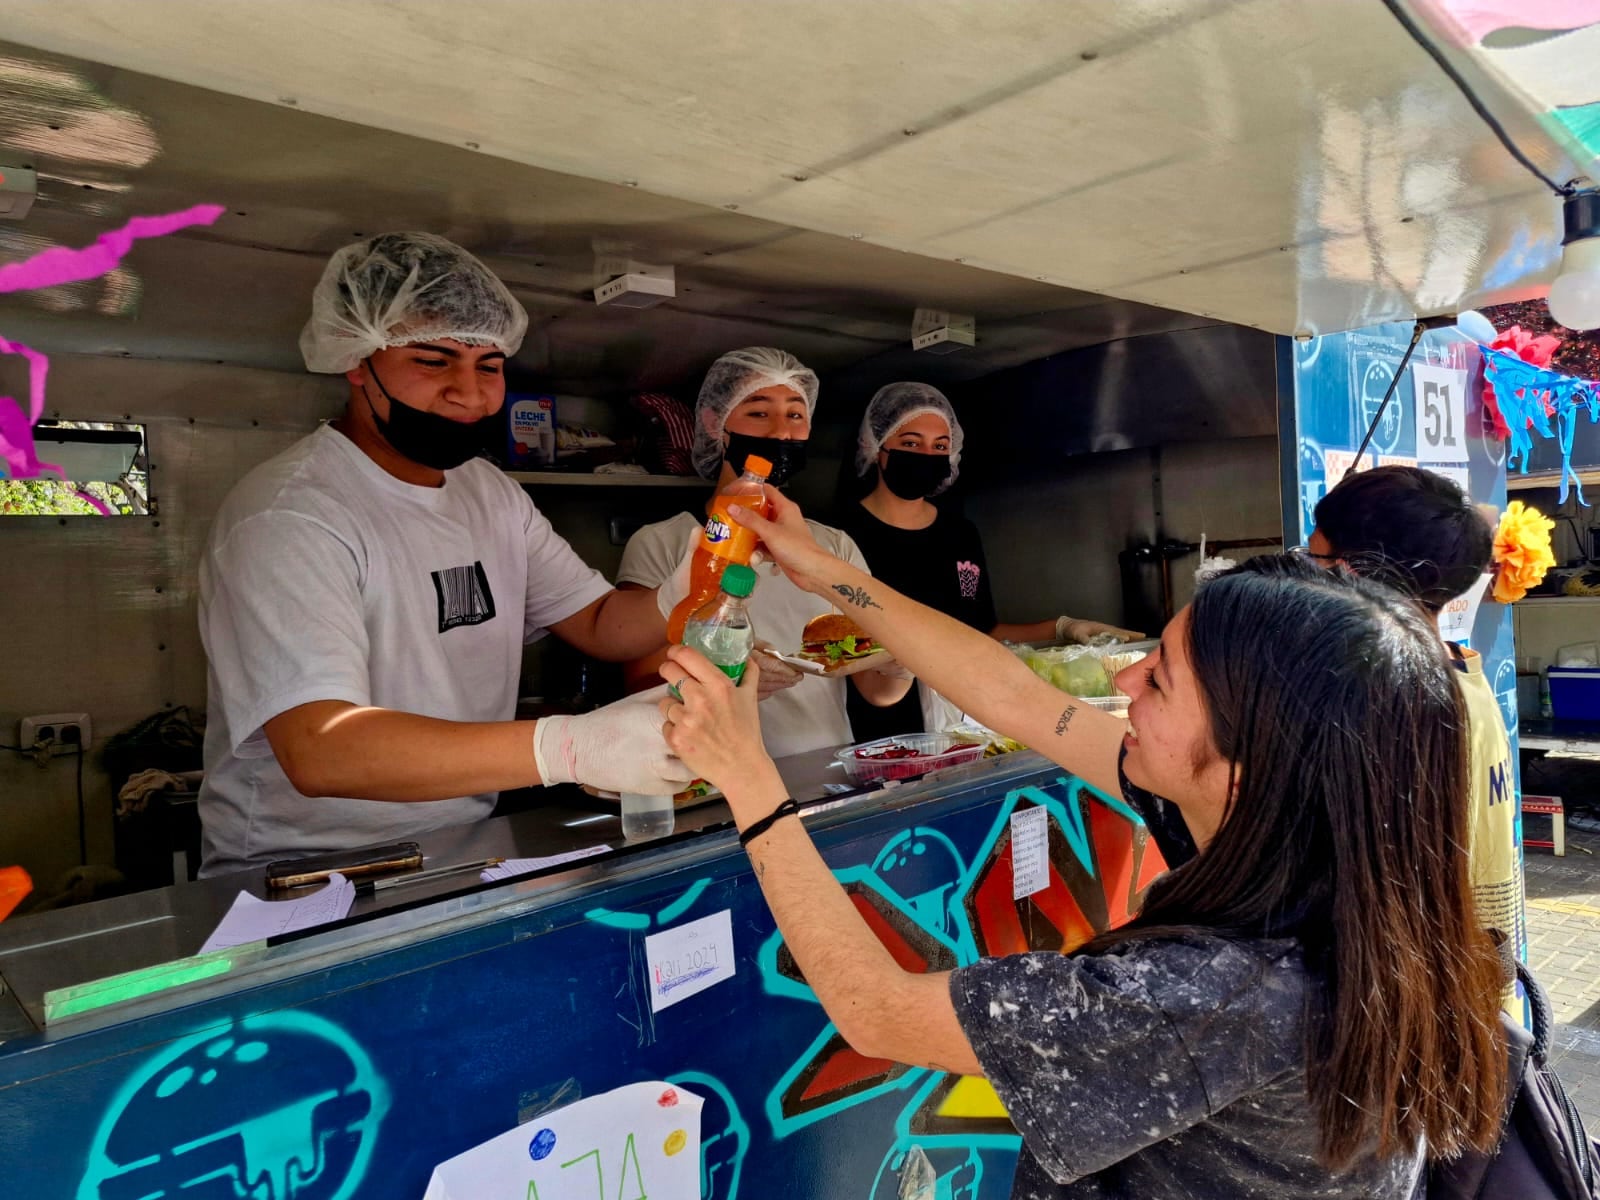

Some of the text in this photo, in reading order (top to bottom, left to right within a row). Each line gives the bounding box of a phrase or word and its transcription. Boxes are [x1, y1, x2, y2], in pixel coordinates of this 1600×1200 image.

[515, 411, 546, 422] LECHE
[1423, 381, 1457, 447] 51
[686, 944, 718, 970] 2024
